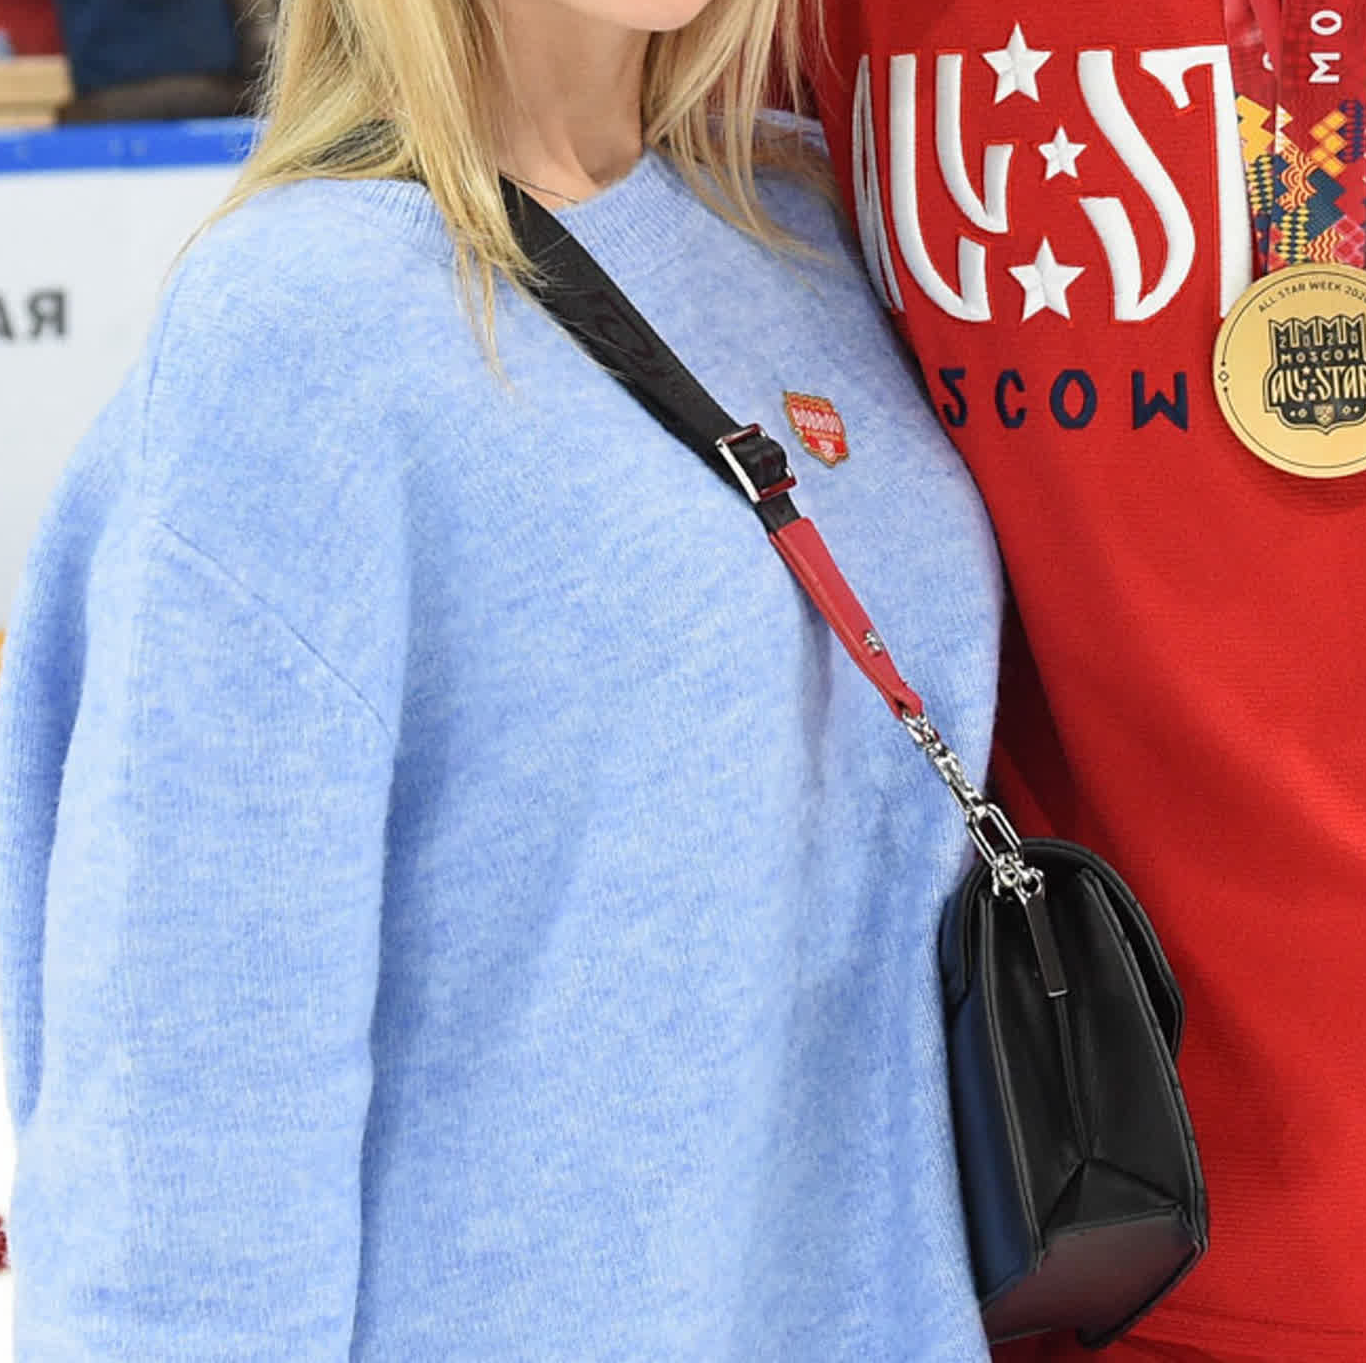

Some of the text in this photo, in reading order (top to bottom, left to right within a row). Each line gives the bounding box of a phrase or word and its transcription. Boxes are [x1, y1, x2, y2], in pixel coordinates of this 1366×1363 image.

[1258, 296, 1277, 313] ALL
[1278, 283, 1306, 299] STAR
[1309, 281, 1341, 292] WEEK
[1281, 348, 1359, 365] MOSCOW
